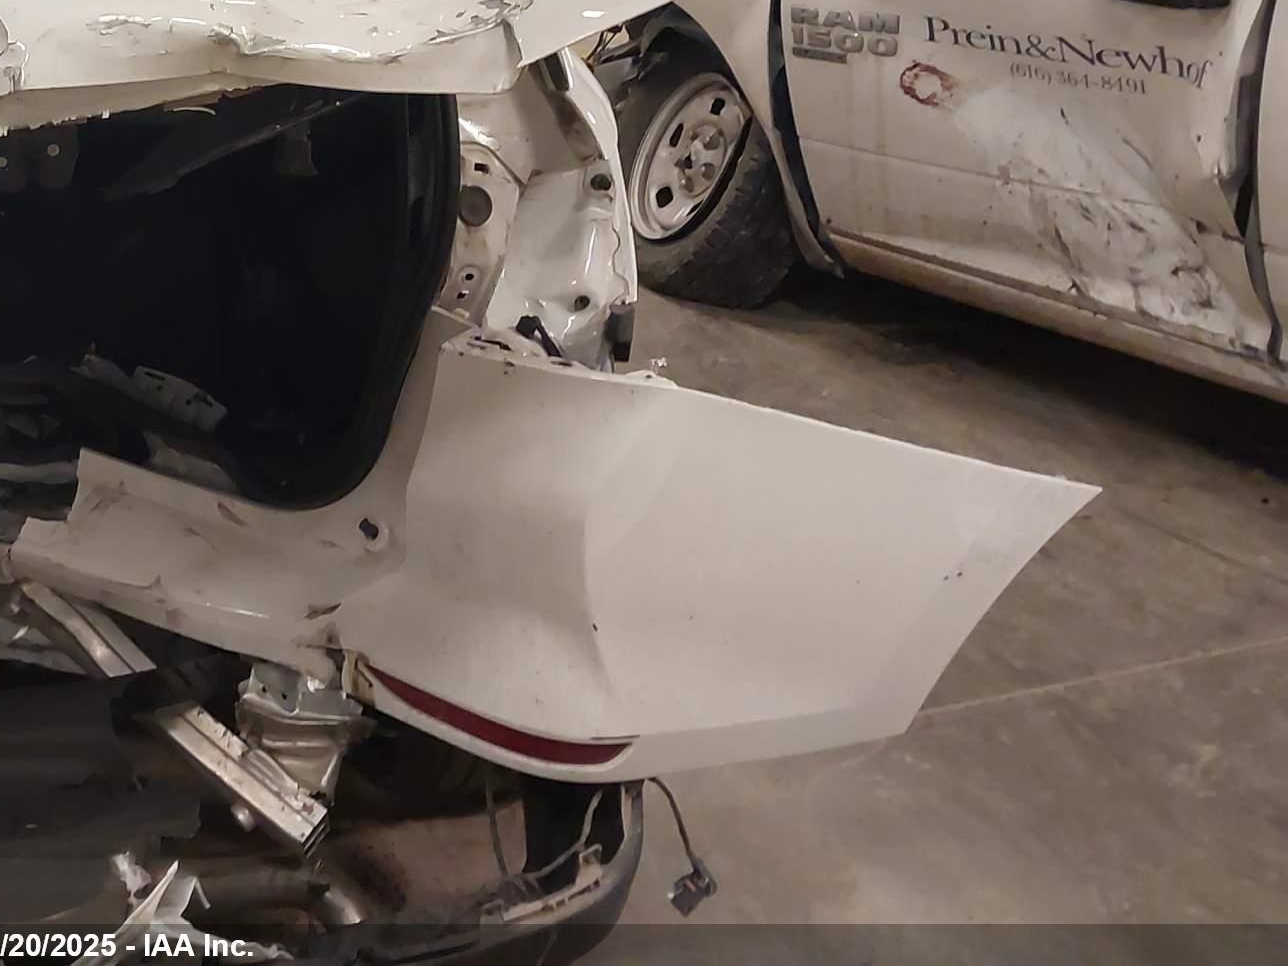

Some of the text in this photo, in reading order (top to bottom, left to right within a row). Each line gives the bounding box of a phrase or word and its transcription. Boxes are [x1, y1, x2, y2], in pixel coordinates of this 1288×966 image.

[791, 7, 901, 34] RAM
[792, 25, 898, 57] 1500
[924, 15, 1213, 89] Prein&Newhof
